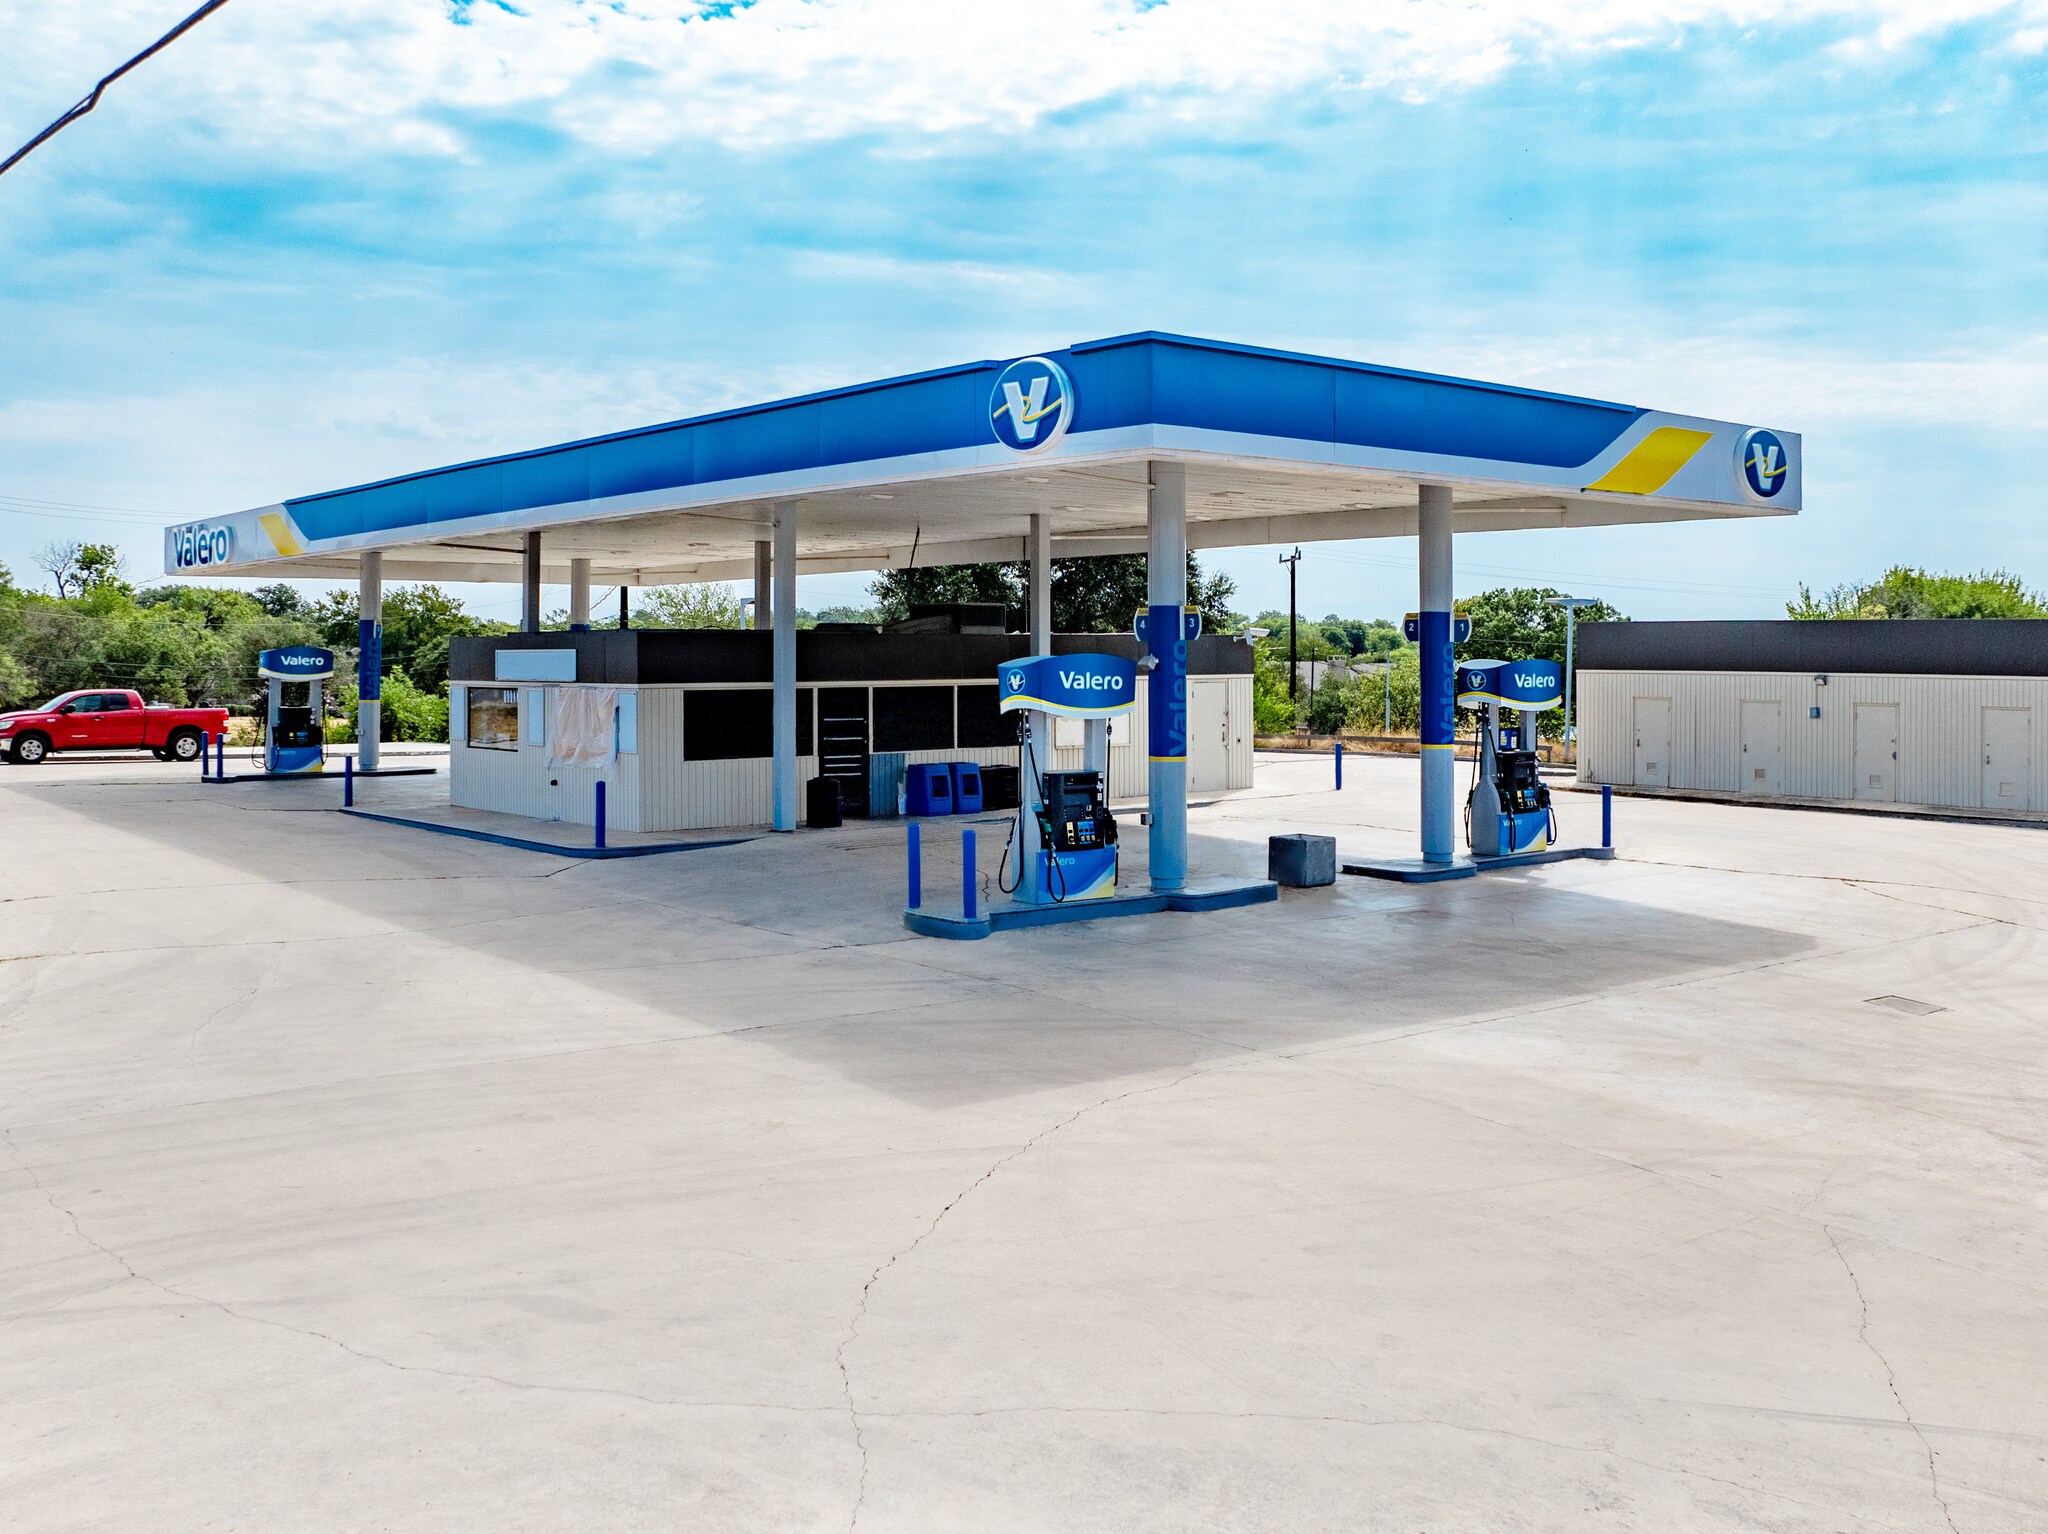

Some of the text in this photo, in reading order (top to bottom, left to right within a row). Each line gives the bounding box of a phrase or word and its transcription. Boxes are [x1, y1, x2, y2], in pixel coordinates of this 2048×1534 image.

[173, 525, 227, 568] Valero
[1140, 619, 1146, 630] 4
[1189, 618, 1195, 628] 3
[1408, 622, 1415, 632] 2
[1459, 623, 1465, 632] 1
[280, 655, 324, 666] Valero
[1059, 670, 1123, 690] Valero
[1514, 673, 1555, 688] Valero
